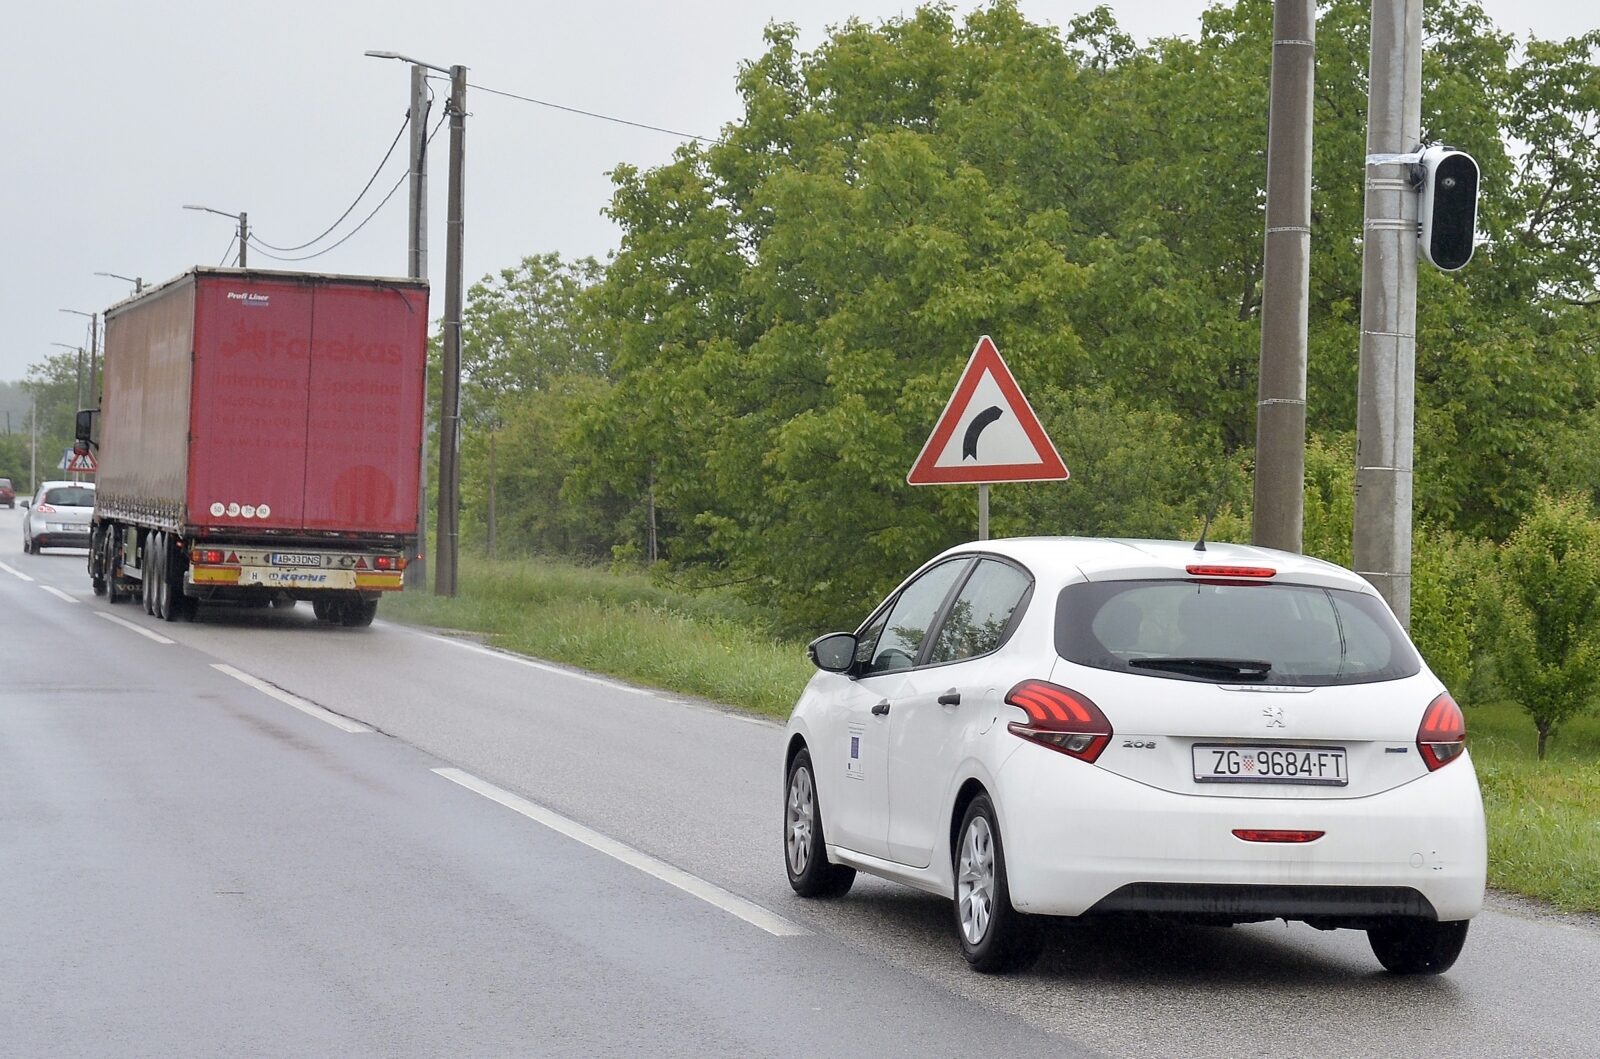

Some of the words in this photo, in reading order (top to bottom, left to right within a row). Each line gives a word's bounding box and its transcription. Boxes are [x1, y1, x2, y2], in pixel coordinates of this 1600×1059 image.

[227, 292, 248, 300] Profi
[248, 293, 270, 301] Liner
[271, 330, 402, 365] Fazekas
[280, 573, 327, 583] KRONE
[1122, 740, 1157, 750] 208
[1212, 750, 1241, 775] ZG
